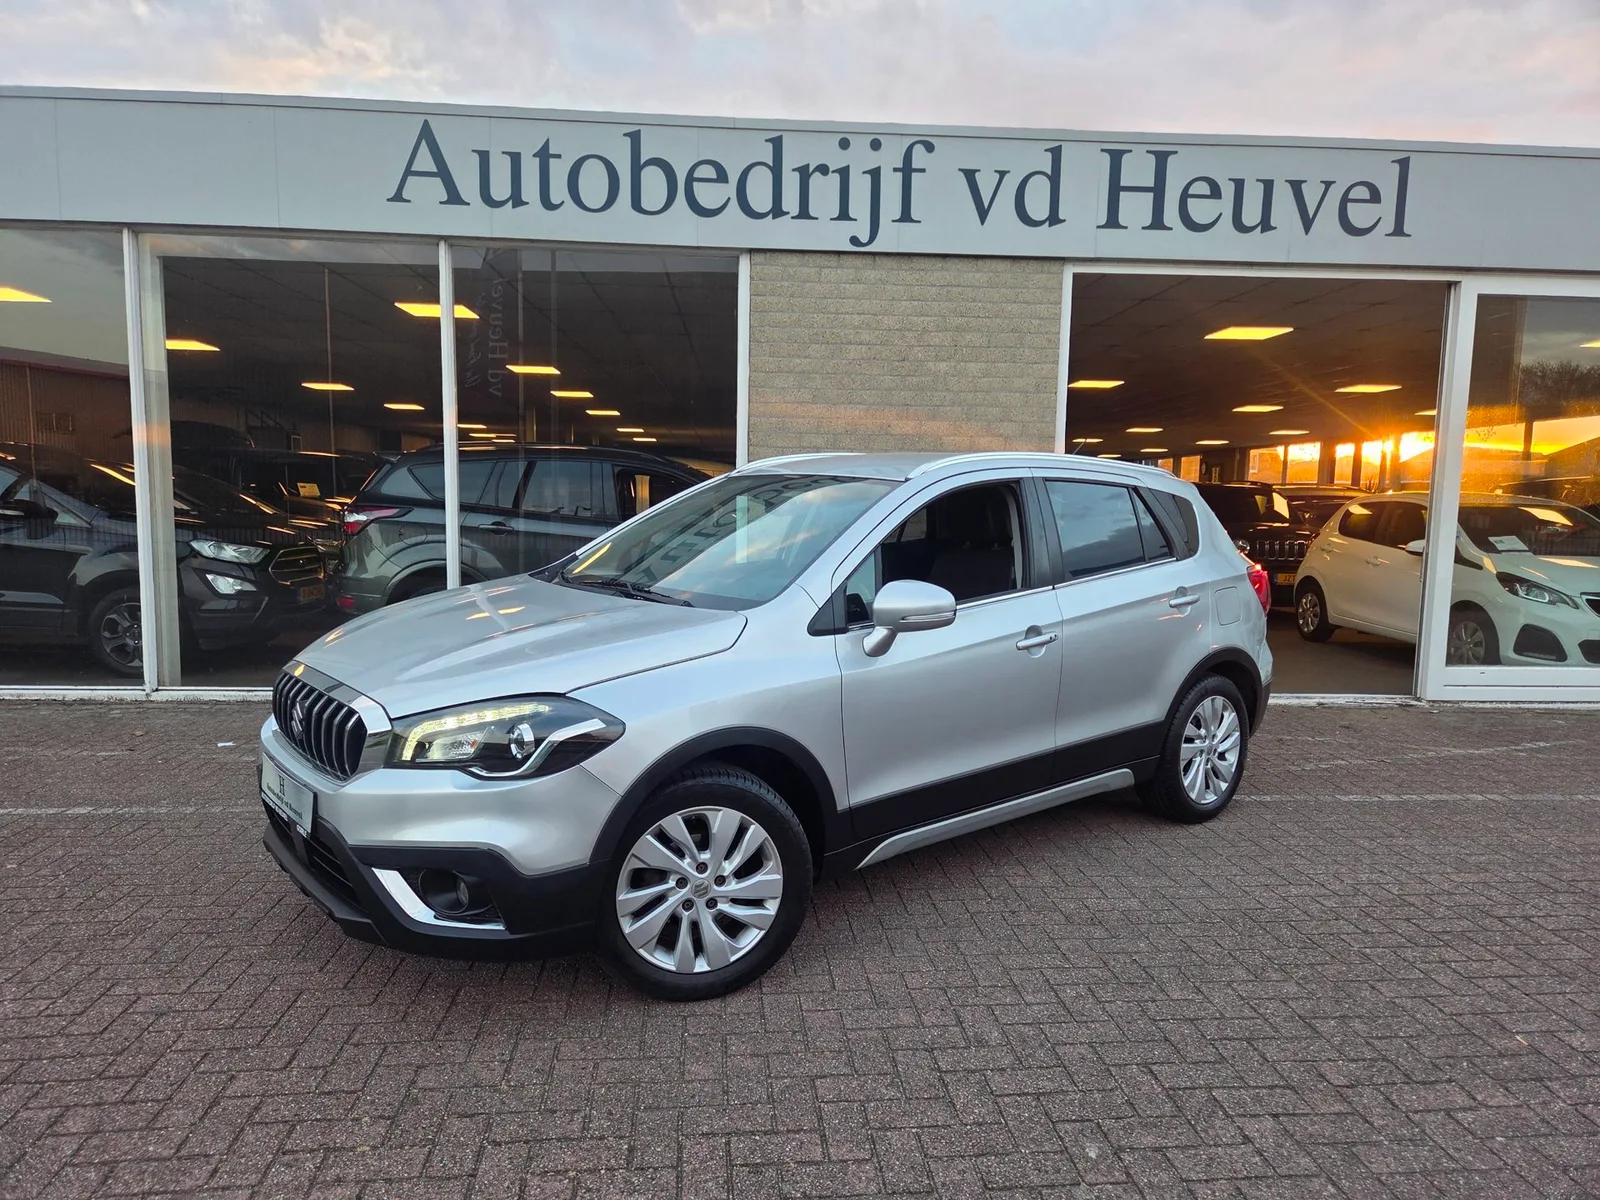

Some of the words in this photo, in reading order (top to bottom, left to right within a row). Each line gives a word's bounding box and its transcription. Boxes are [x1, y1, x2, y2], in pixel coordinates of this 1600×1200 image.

[386, 119, 935, 247] Autobedrijf
[958, 143, 1067, 228] vd
[1096, 147, 1412, 238] Heuvel
